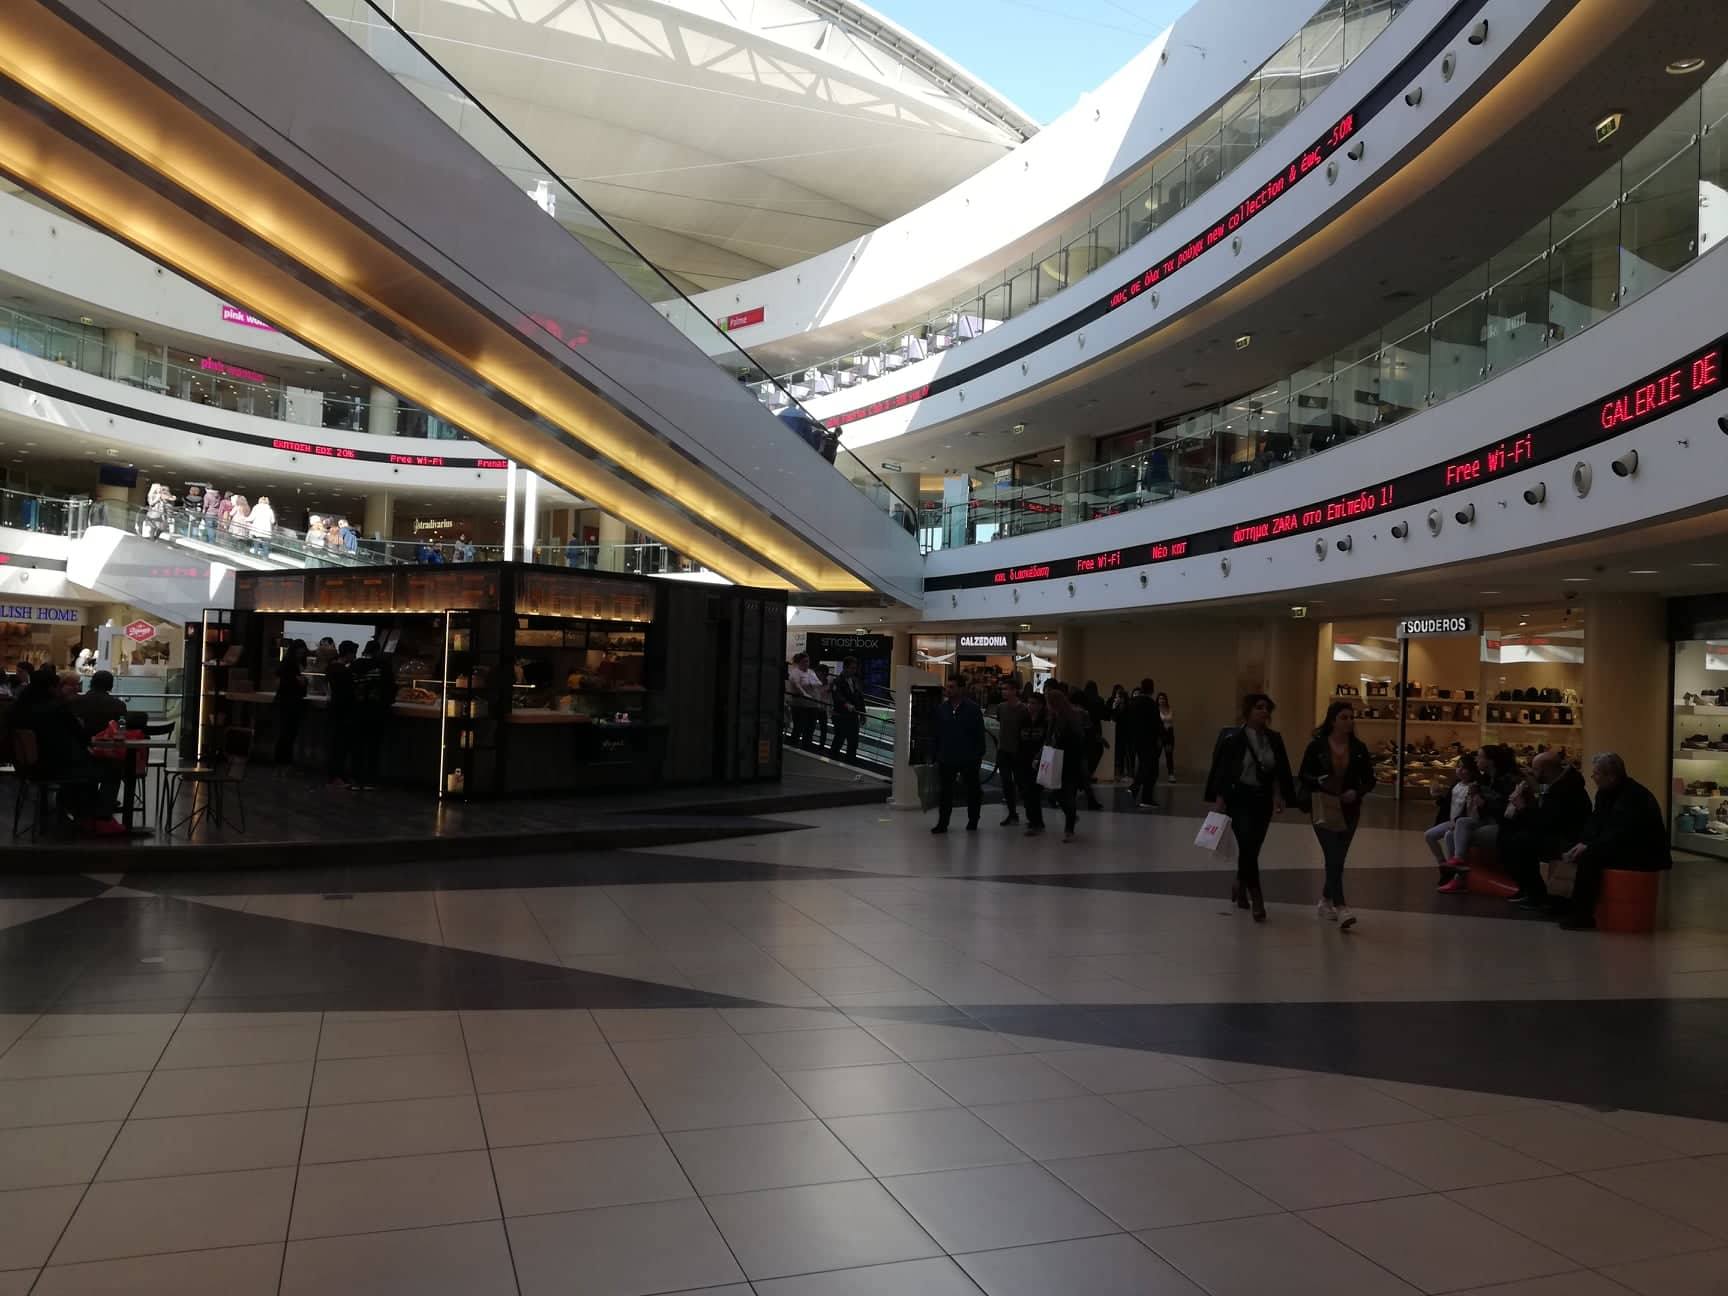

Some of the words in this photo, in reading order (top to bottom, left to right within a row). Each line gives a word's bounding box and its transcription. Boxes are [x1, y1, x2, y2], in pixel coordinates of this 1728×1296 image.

[1207, 223, 1225, 245] new
[1228, 177, 1284, 230] collection
[1289, 164, 1297, 182] &
[223, 309, 244, 322] pink
[1601, 370, 1682, 430] GALERIE
[1692, 351, 1718, 391] DE
[390, 454, 412, 464] Free
[416, 457, 443, 466] Wi-Fi
[1446, 459, 1480, 486] Free
[1487, 433, 1533, 473] Wi-Fi
[1272, 513, 1298, 534] ZARA
[1303, 509, 1322, 527] στο
[1327, 491, 1375, 521] Επίπεδο
[1380, 484, 1394, 506] 1!
[1077, 558, 1095, 571] Free
[1097, 551, 1121, 568] Wi-Fi
[36, 607, 79, 622] HOME
[1401, 618, 1467, 633] TSOUDEROS
[821, 634, 879, 650] smashbox
[960, 636, 1008, 647] CALZEDONIA
